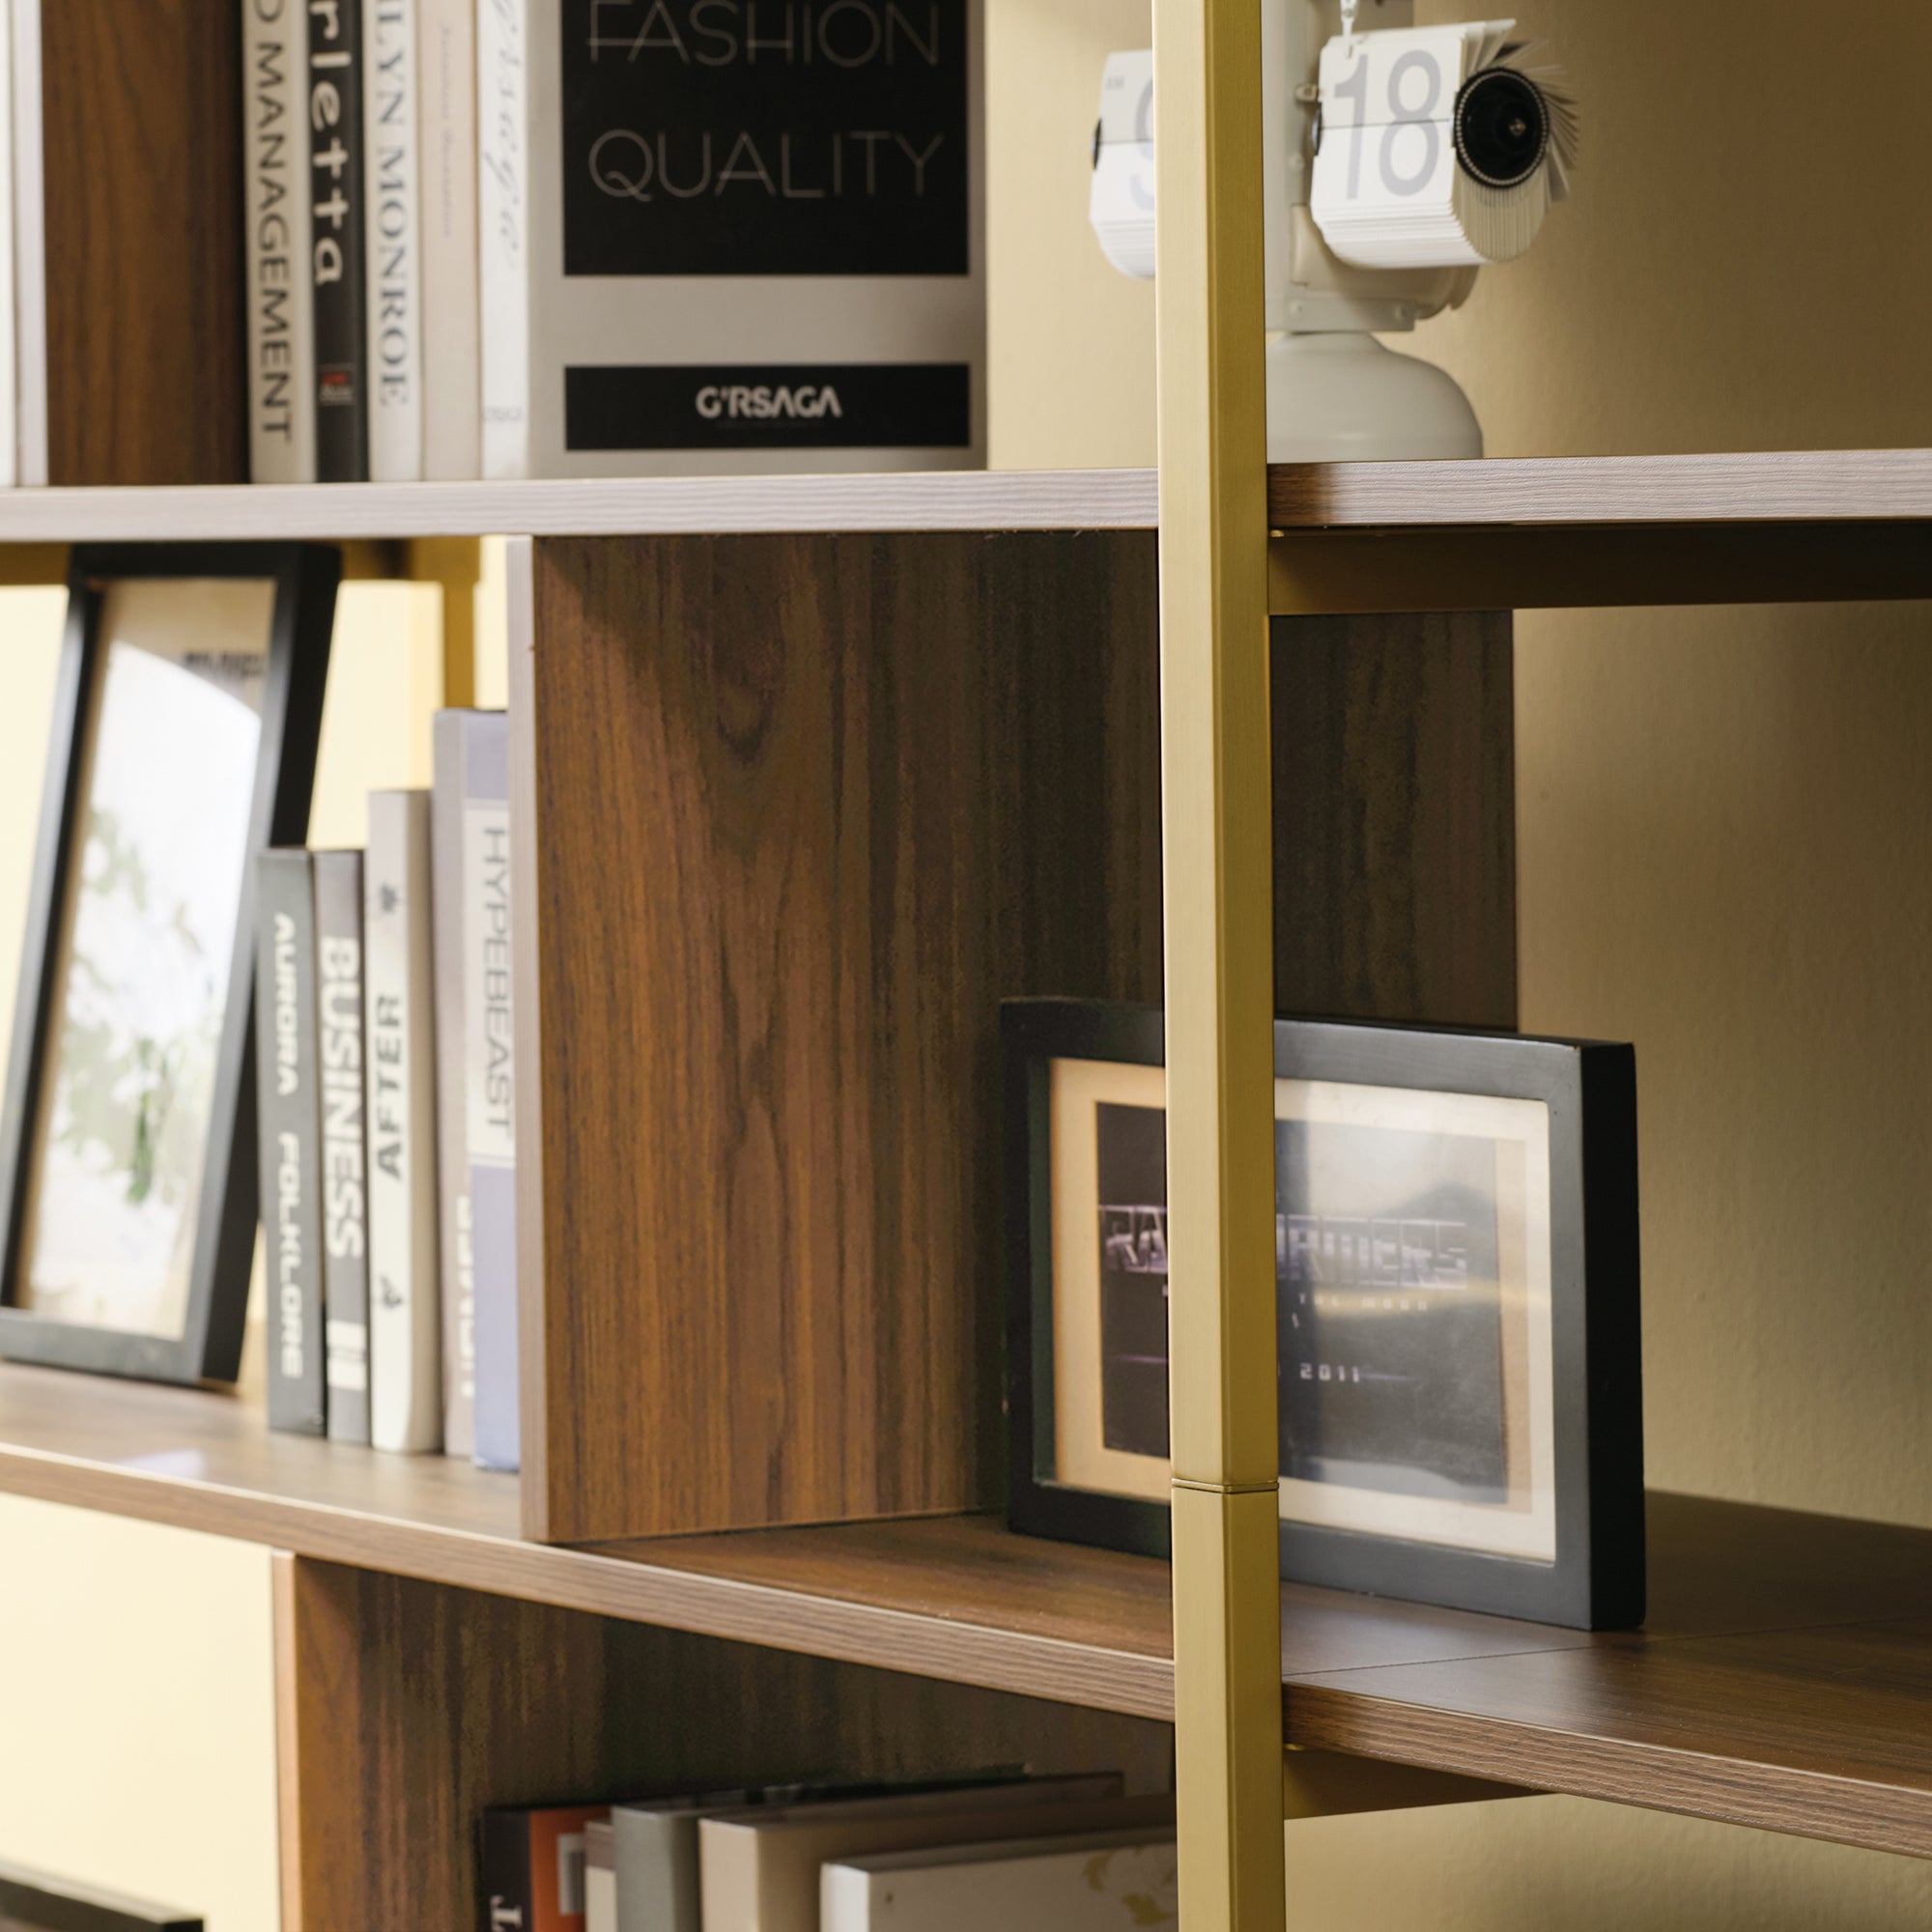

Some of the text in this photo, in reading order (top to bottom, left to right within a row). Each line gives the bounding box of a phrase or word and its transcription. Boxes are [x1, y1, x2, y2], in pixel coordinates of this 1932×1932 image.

[585, 0, 940, 68] FASHION
[1333, 48, 1442, 200] 18
[255, 41, 293, 443] MANAGEMENT
[377, 146, 410, 409] MONROE
[587, 128, 945, 203] QUALITY
[375, 995, 405, 1180] AFTER
[483, 824, 514, 1139] HYPEBEAST
[274, 912, 304, 1379] AURORA FOLKLORE
[320, 935, 366, 1261] BUSINESS
[1299, 1362, 1362, 1383] 2011
